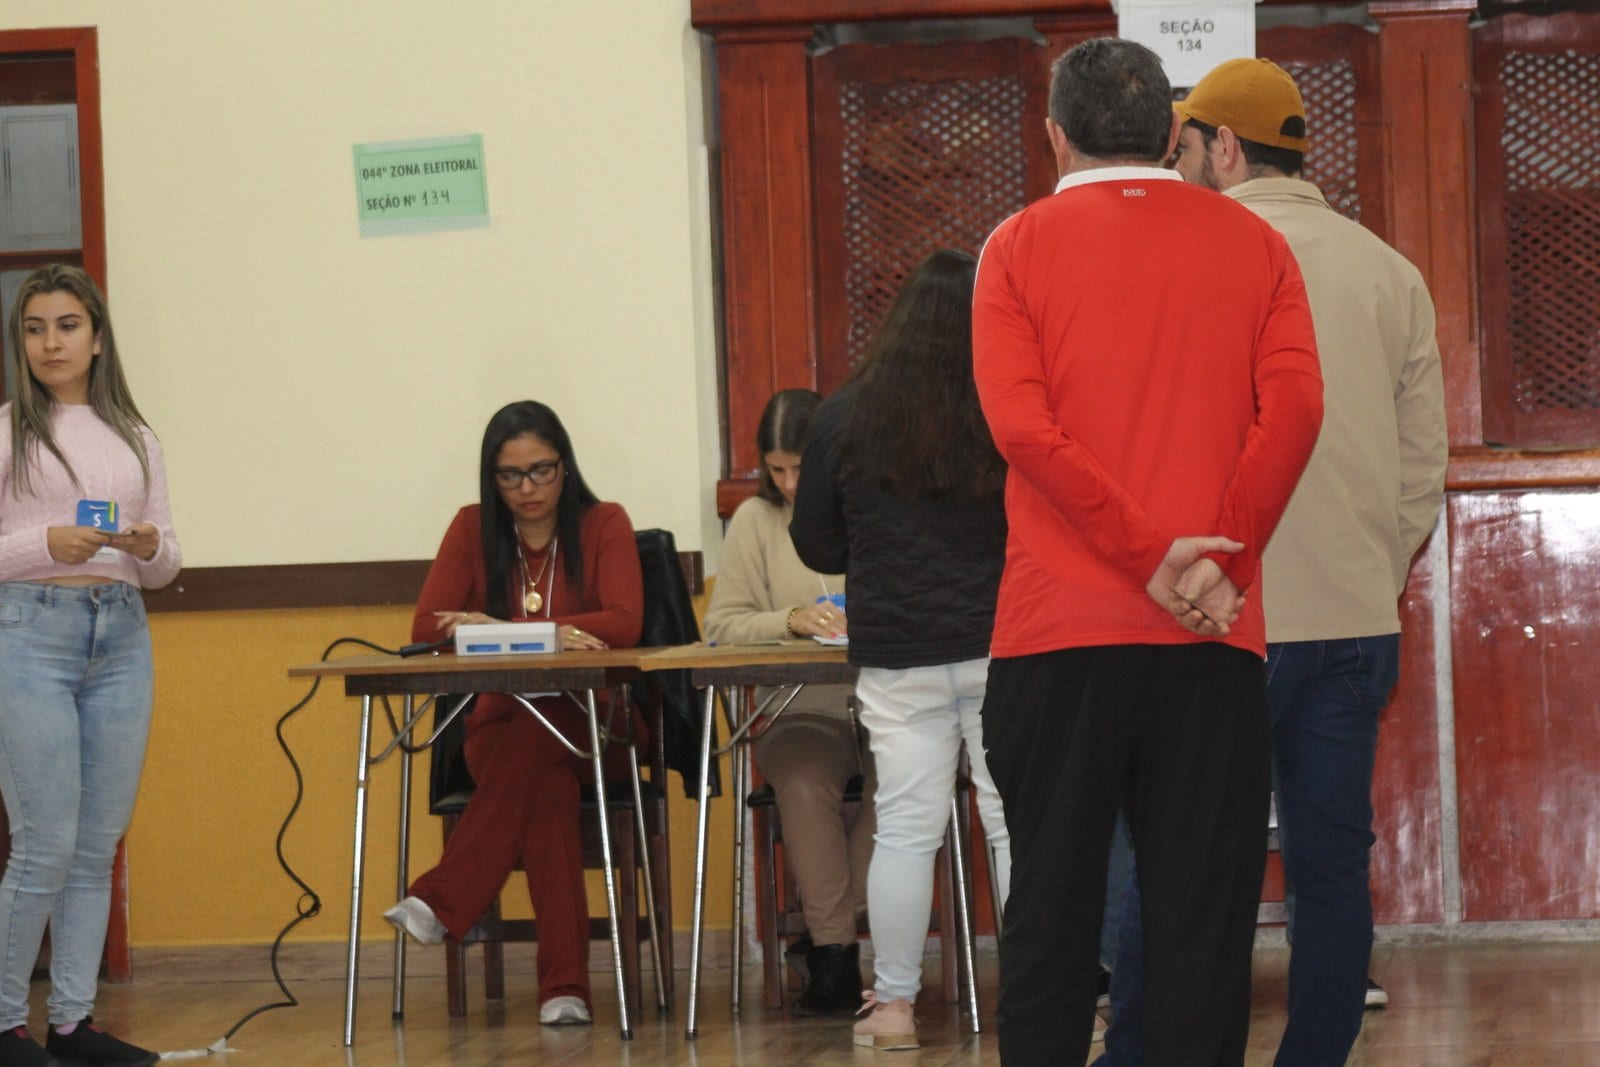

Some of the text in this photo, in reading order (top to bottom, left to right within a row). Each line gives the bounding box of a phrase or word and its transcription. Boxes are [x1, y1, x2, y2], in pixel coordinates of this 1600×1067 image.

[1160, 19, 1215, 36] SEÇÃO
[1177, 39, 1202, 51] 134
[391, 163, 420, 178] ZONA
[424, 158, 478, 174] ELEITORAL
[366, 195, 400, 212] SEÇÃO
[422, 190, 450, 206] 134
